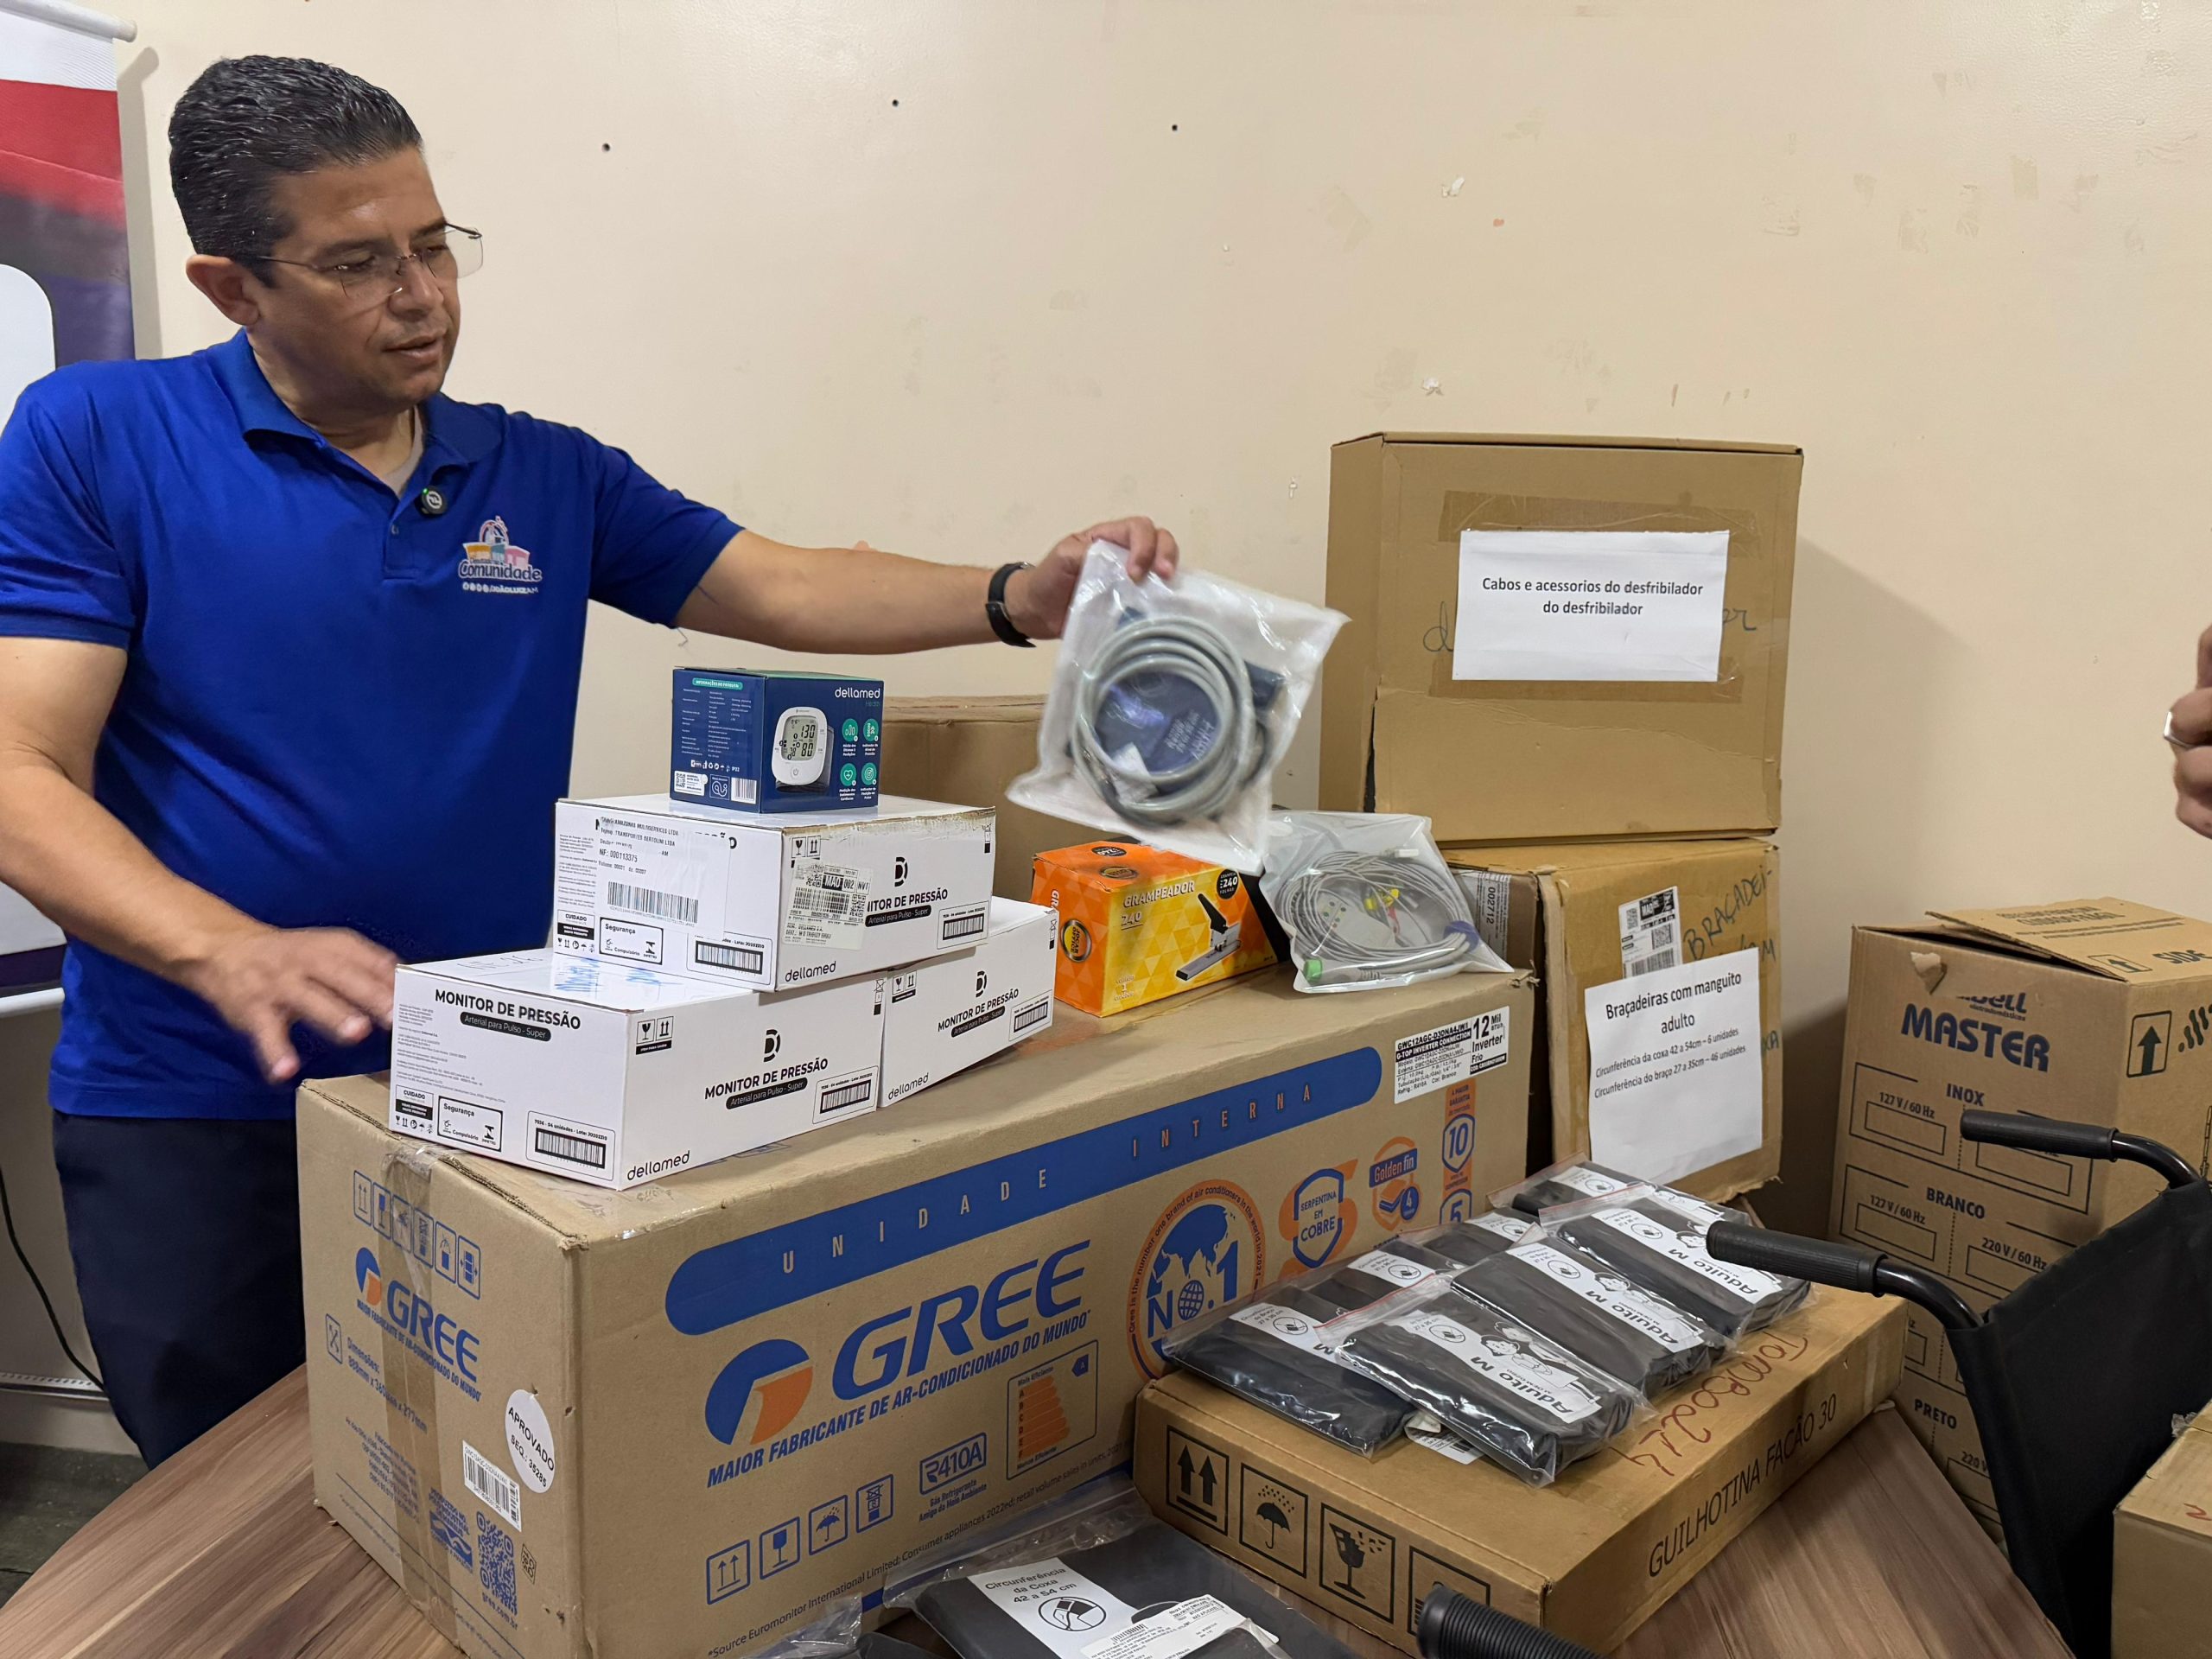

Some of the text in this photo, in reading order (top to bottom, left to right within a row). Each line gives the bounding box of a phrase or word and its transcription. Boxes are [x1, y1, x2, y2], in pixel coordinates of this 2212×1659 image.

[459, 560, 542, 582] Comunidade
[1482, 577, 1703, 596] Cabos e acessorios do desfribilador
[1542, 600, 1643, 616] do desfribilador
[835, 687, 880, 699] dellamed
[1123, 880, 1195, 908] GRAMPEADOR
[1223, 876, 1238, 887] 240
[894, 888, 948, 908] DE PRESSÃO
[1486, 887, 1496, 925] 002712
[606, 923, 636, 935] Segurança
[868, 907, 929, 925] Arterial para Pulso Super
[1121, 912, 1143, 927] 240
[785, 961, 836, 982] dellamed
[435, 988, 581, 1030] MONITOR DE PRESSÃO
[1605, 971, 1742, 1020] Braçadeiras com manguito
[938, 988, 1019, 1033] MONITOR DE PRESSÃO
[1661, 1013, 1695, 1034] adulto
[464, 1014, 547, 1039] Arterial para Pulso Super
[1473, 1013, 1502, 1039] 12 Mil
[1902, 1003, 2050, 1072] MASTER
[1471, 1034, 1503, 1053] Inverter
[1596, 1055, 1641, 1078] Circunferência
[1643, 1053, 1651, 1065] da
[1652, 1050, 1669, 1063] coxa
[1670, 1046, 1678, 1057] 42
[1684, 1039, 1702, 1052] 54cm
[1713, 1027, 1739, 1045] unidades
[1471, 1055, 1483, 1064] Frio
[1594, 1043, 1746, 1098] Circunferência do braço 27 35cm 46 unidades
[704, 1058, 828, 1100] MONITOR DE PRESSÃO
[730, 1080, 804, 1106] Arterial para Pulso Super
[888, 1072, 929, 1100] dellamed
[404, 1090, 426, 1100] CUIDADO
[1879, 1091, 1895, 1104] 127
[1908, 1100, 1921, 1113] 60
[1923, 1104, 1936, 1119] Hz
[1946, 1084, 1985, 1106] INOX
[443, 1103, 475, 1117] Segurança
[1133, 1084, 1312, 1158] INTERNA
[453, 1129, 480, 1141] Compulsório
[1450, 1127, 1468, 1159] 10
[627, 1150, 690, 1181] dellamed
[1374, 1155, 1414, 1183] Golden fin
[1300, 1191, 1338, 1211] SERPENTINA
[1313, 1210, 1324, 1219] EM
[1451, 1200, 1463, 1223] 5
[1870, 1194, 1885, 1207] 127
[1899, 1203, 1911, 1216] 60
[1912, 1209, 1926, 1224] Hz
[1926, 1187, 1986, 1219] BRANCO
[782, 1168, 1047, 1274] UNIDADE
[1138, 1240, 1155, 1275] number
[1155, 1221, 1166, 1236] one
[1166, 1199, 1186, 1220] brand
[1185, 1192, 1194, 1204] of
[1194, 1189, 1204, 1199] air
[1205, 1185, 1242, 1204] conditioners
[1300, 1216, 1336, 1243] COBRE
[1981, 1237, 2048, 1271] 220 V 60 Hz
[1669, 1249, 1758, 1295] Adulto M
[831, 1239, 1091, 1402] GREE
[1585, 1290, 1678, 1344] Adulto M
[387, 1280, 480, 1383] GREE
[451, 1372, 459, 1386] DO
[1470, 1356, 1573, 1414] Adulto M
[707, 1448, 764, 1489] MAIOR
[769, 1411, 865, 1462] FABRICANTE
[869, 1402, 889, 1419] DE
[891, 1339, 1020, 1409] AR-CONDICIONADO
[1022, 1331, 1040, 1350] DO
[1914, 1398, 1957, 1429] PRETO
[508, 1407, 555, 1471] APROVADO
[510, 1433, 547, 1488] SEQ.: 35285
[1961, 1451, 1980, 1468] 220
[1649, 1393, 1837, 1577] GUILHOTINA FACÃO 30
[748, 1605, 807, 1639] Euromonitor
[809, 1573, 864, 1611] International
[902, 1538, 943, 1564] Consumer
[944, 1516, 986, 1545] appliances
[1016, 1487, 1035, 1505] retail
[1036, 1474, 1062, 1493] volume
[985, 1567, 1066, 1592] Circunferência
[1014, 1577, 1058, 1594] da Coxa
[1014, 1592, 1028, 1604] 42
[1039, 1586, 1058, 1598] 54
[1059, 1582, 1077, 1592] cm
